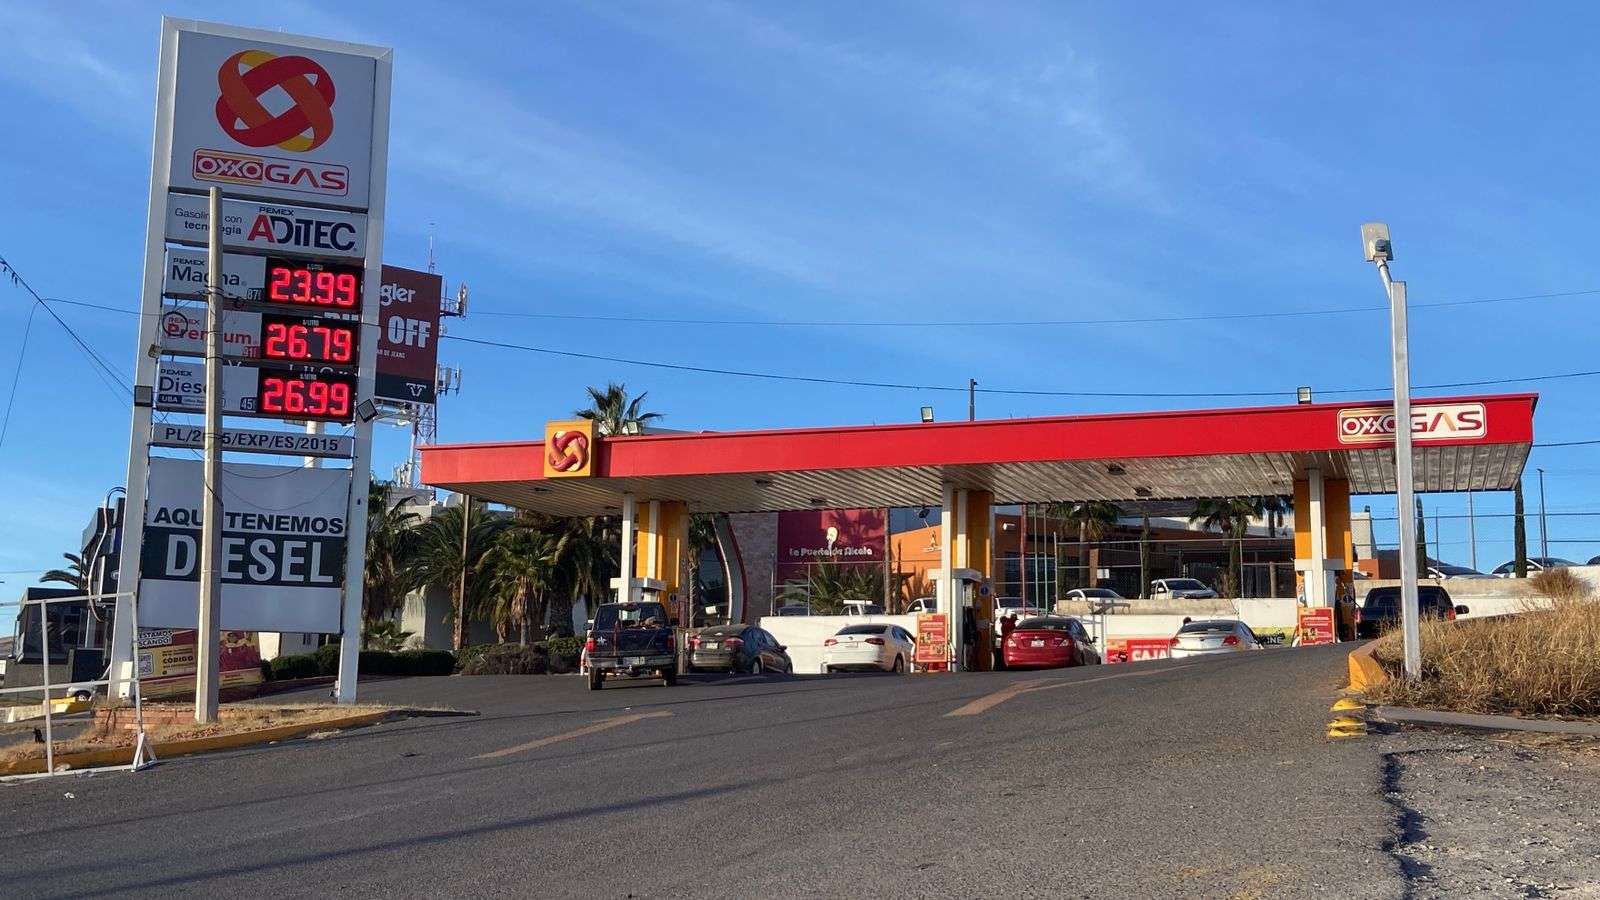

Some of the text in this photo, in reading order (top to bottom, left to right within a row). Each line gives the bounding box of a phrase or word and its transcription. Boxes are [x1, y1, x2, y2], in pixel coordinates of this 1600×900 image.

[197, 156, 346, 190] OXXOGAS
[174, 207, 242, 224] Gasolin con
[259, 206, 295, 216] PEMEX
[173, 257, 205, 266] PEMEX
[271, 267, 356, 306] 23.99
[380, 283, 416, 307] gler
[167, 323, 252, 345] Preum
[266, 323, 352, 362] 26.79
[387, 314, 432, 349] OFF
[160, 368, 192, 377] PEMEX
[159, 376, 207, 394] Dies
[263, 378, 350, 416] 26.99
[165, 427, 339, 451] PL/25/EXP/ES/2015
[153, 507, 344, 534] AQU TENEMOS
[165, 533, 334, 583] DESEL
